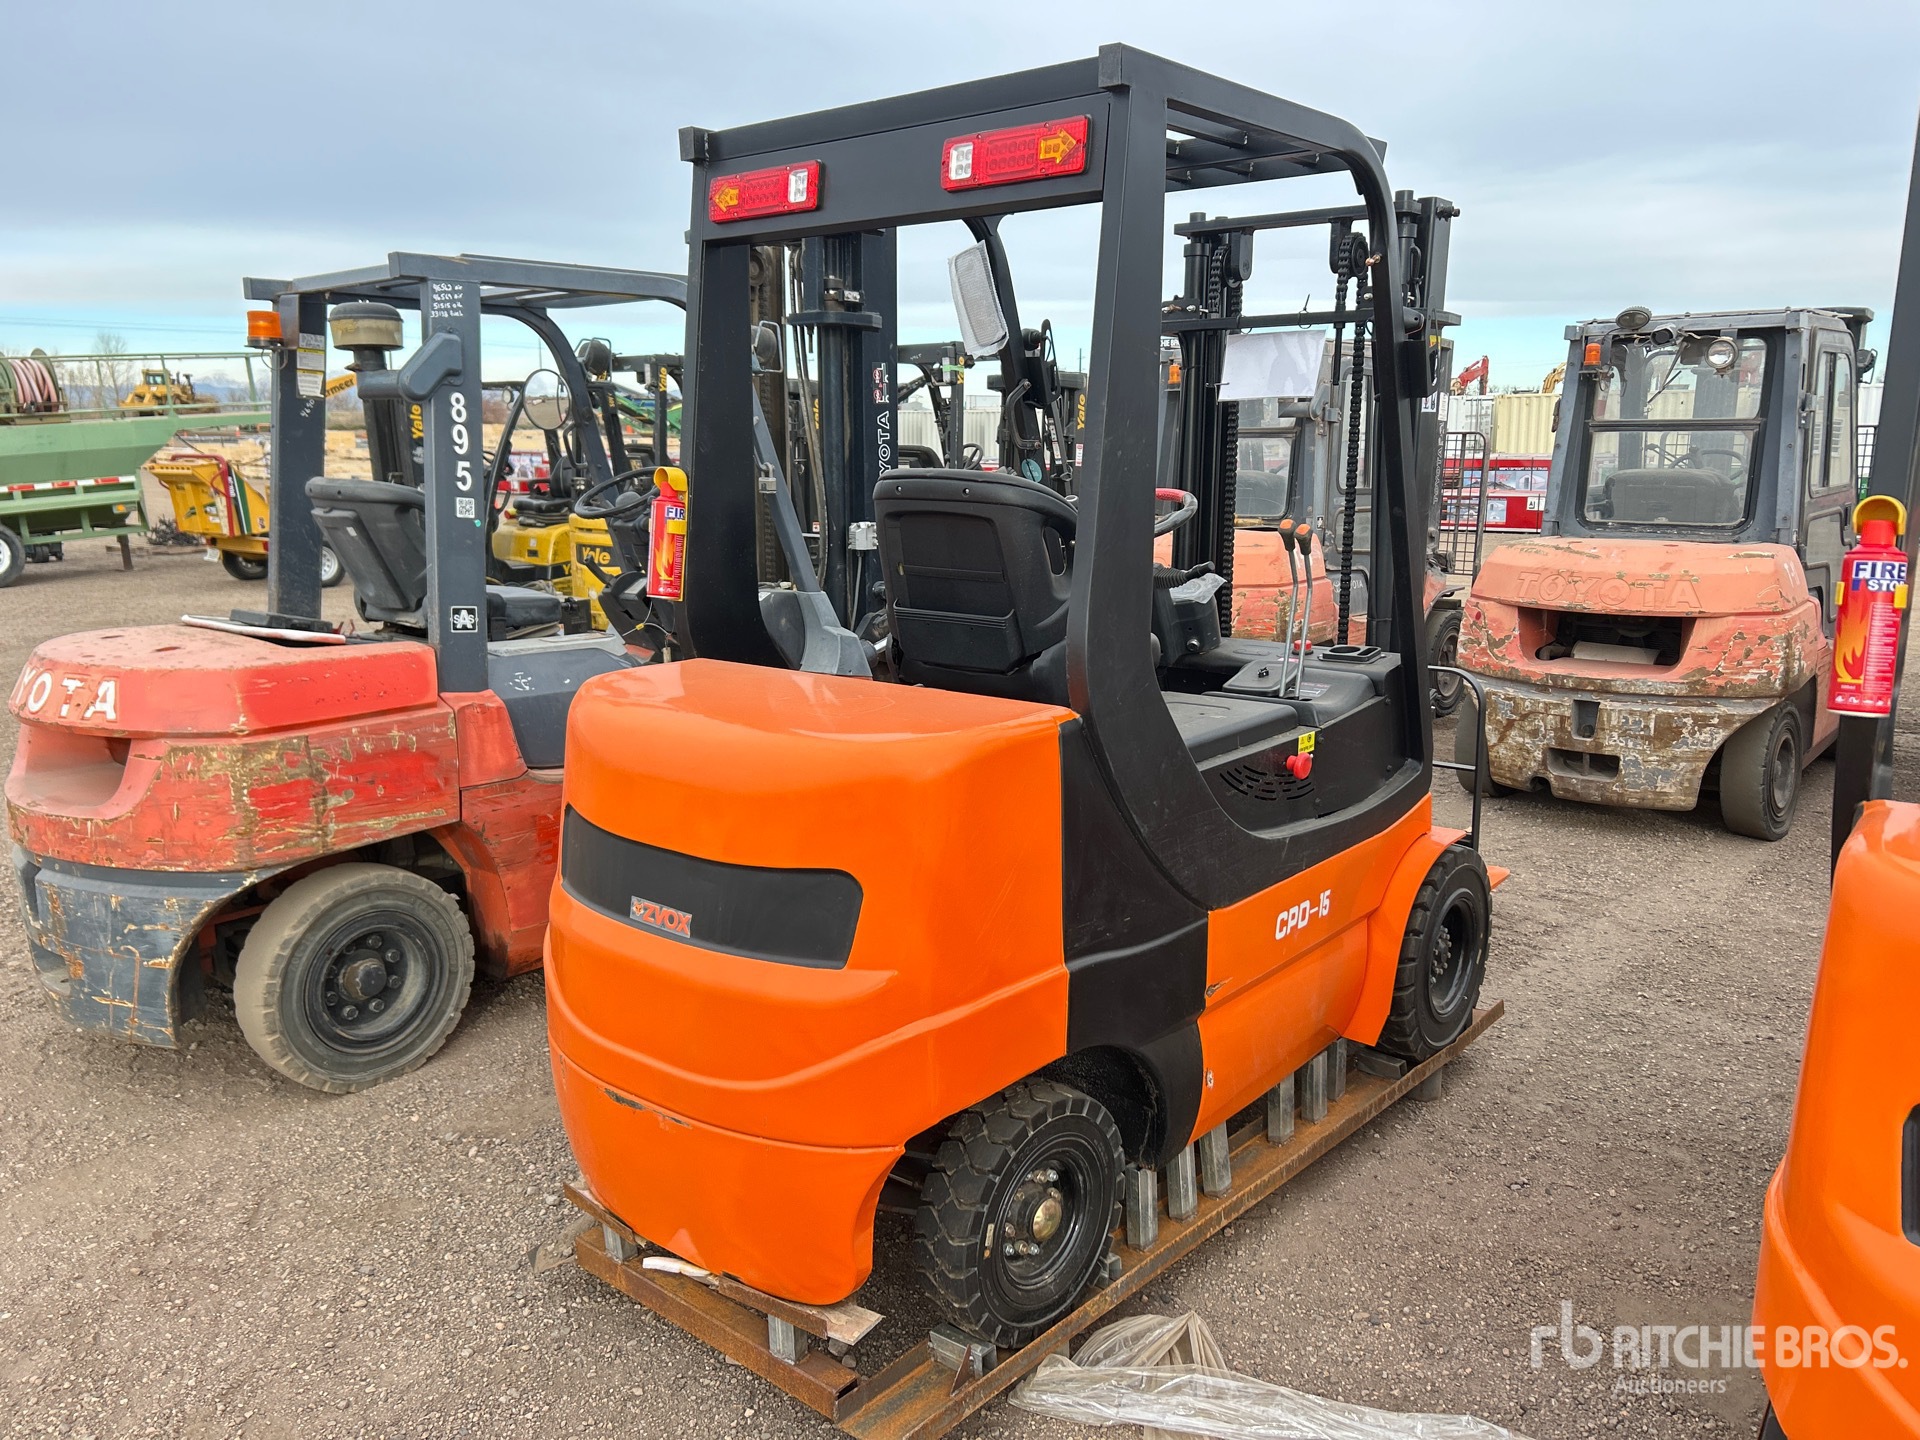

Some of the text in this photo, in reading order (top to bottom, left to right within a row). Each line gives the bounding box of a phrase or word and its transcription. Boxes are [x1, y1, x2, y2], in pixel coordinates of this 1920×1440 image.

[410, 404, 424, 439] Yale
[1077, 393, 1086, 430] Yale
[450, 392, 472, 491] 895
[1854, 561, 1907, 580] FIRE
[1517, 571, 1703, 609] TOYOTA
[642, 901, 691, 935] ZVOX
[1275, 889, 1331, 940] CPD-15
